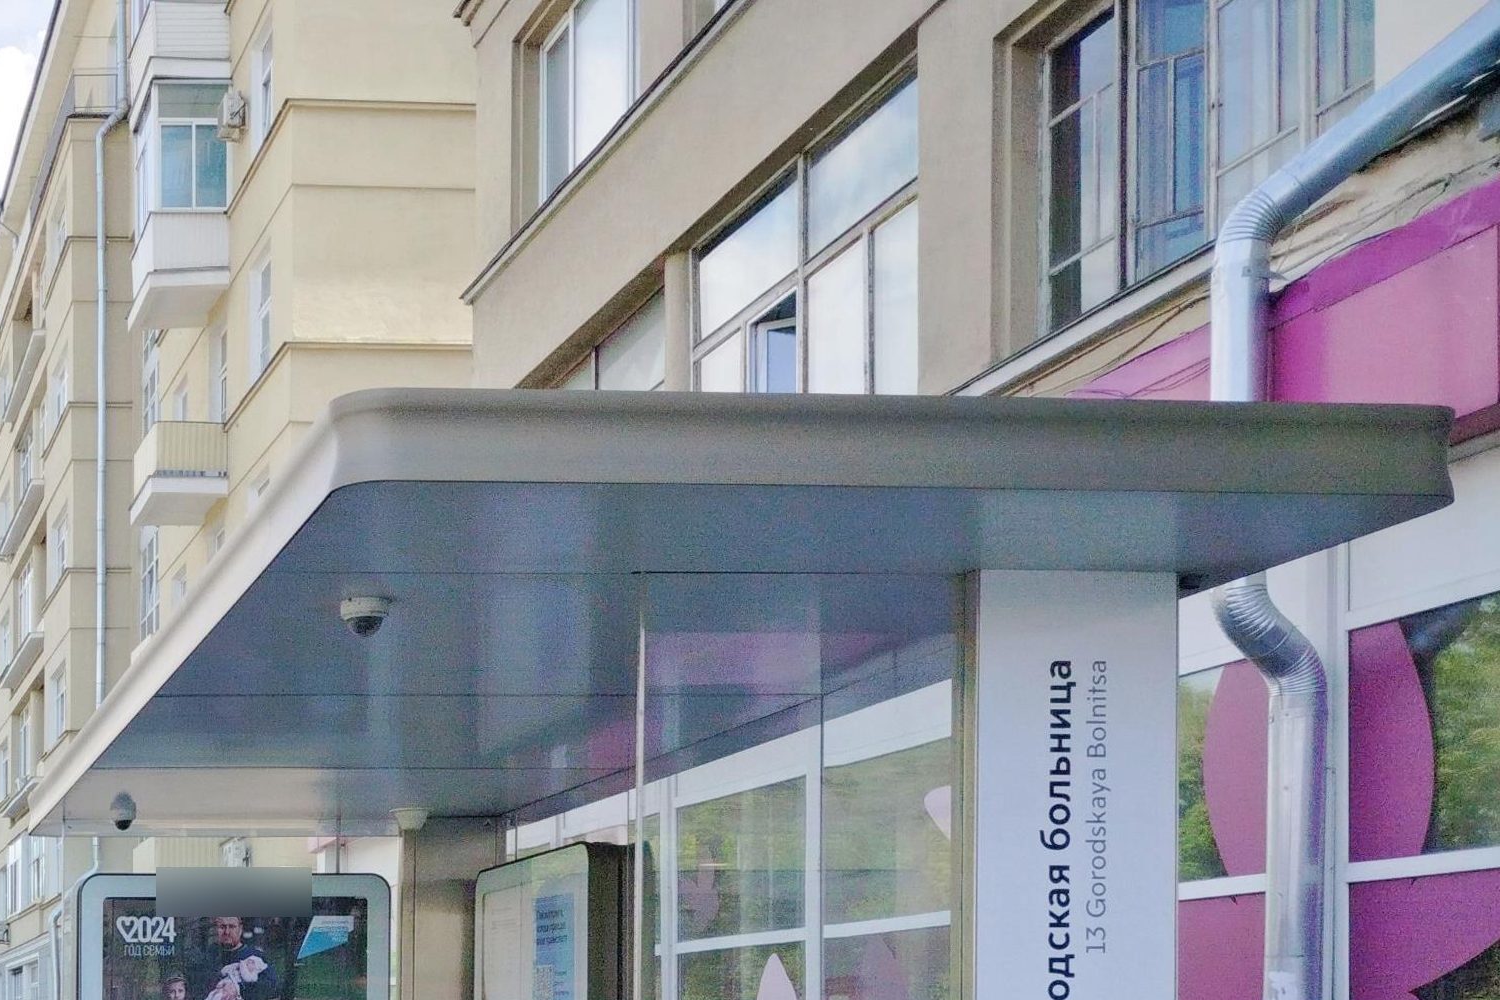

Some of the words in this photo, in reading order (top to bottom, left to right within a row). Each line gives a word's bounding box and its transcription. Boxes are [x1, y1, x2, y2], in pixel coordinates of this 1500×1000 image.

[1039, 659, 1077, 851] больница
[1085, 660, 1108, 758] Bolnitsa
[1085, 768, 1112, 918] Gorodskaya
[116, 916, 177, 942] 2024
[1086, 926, 1107, 954] 13
